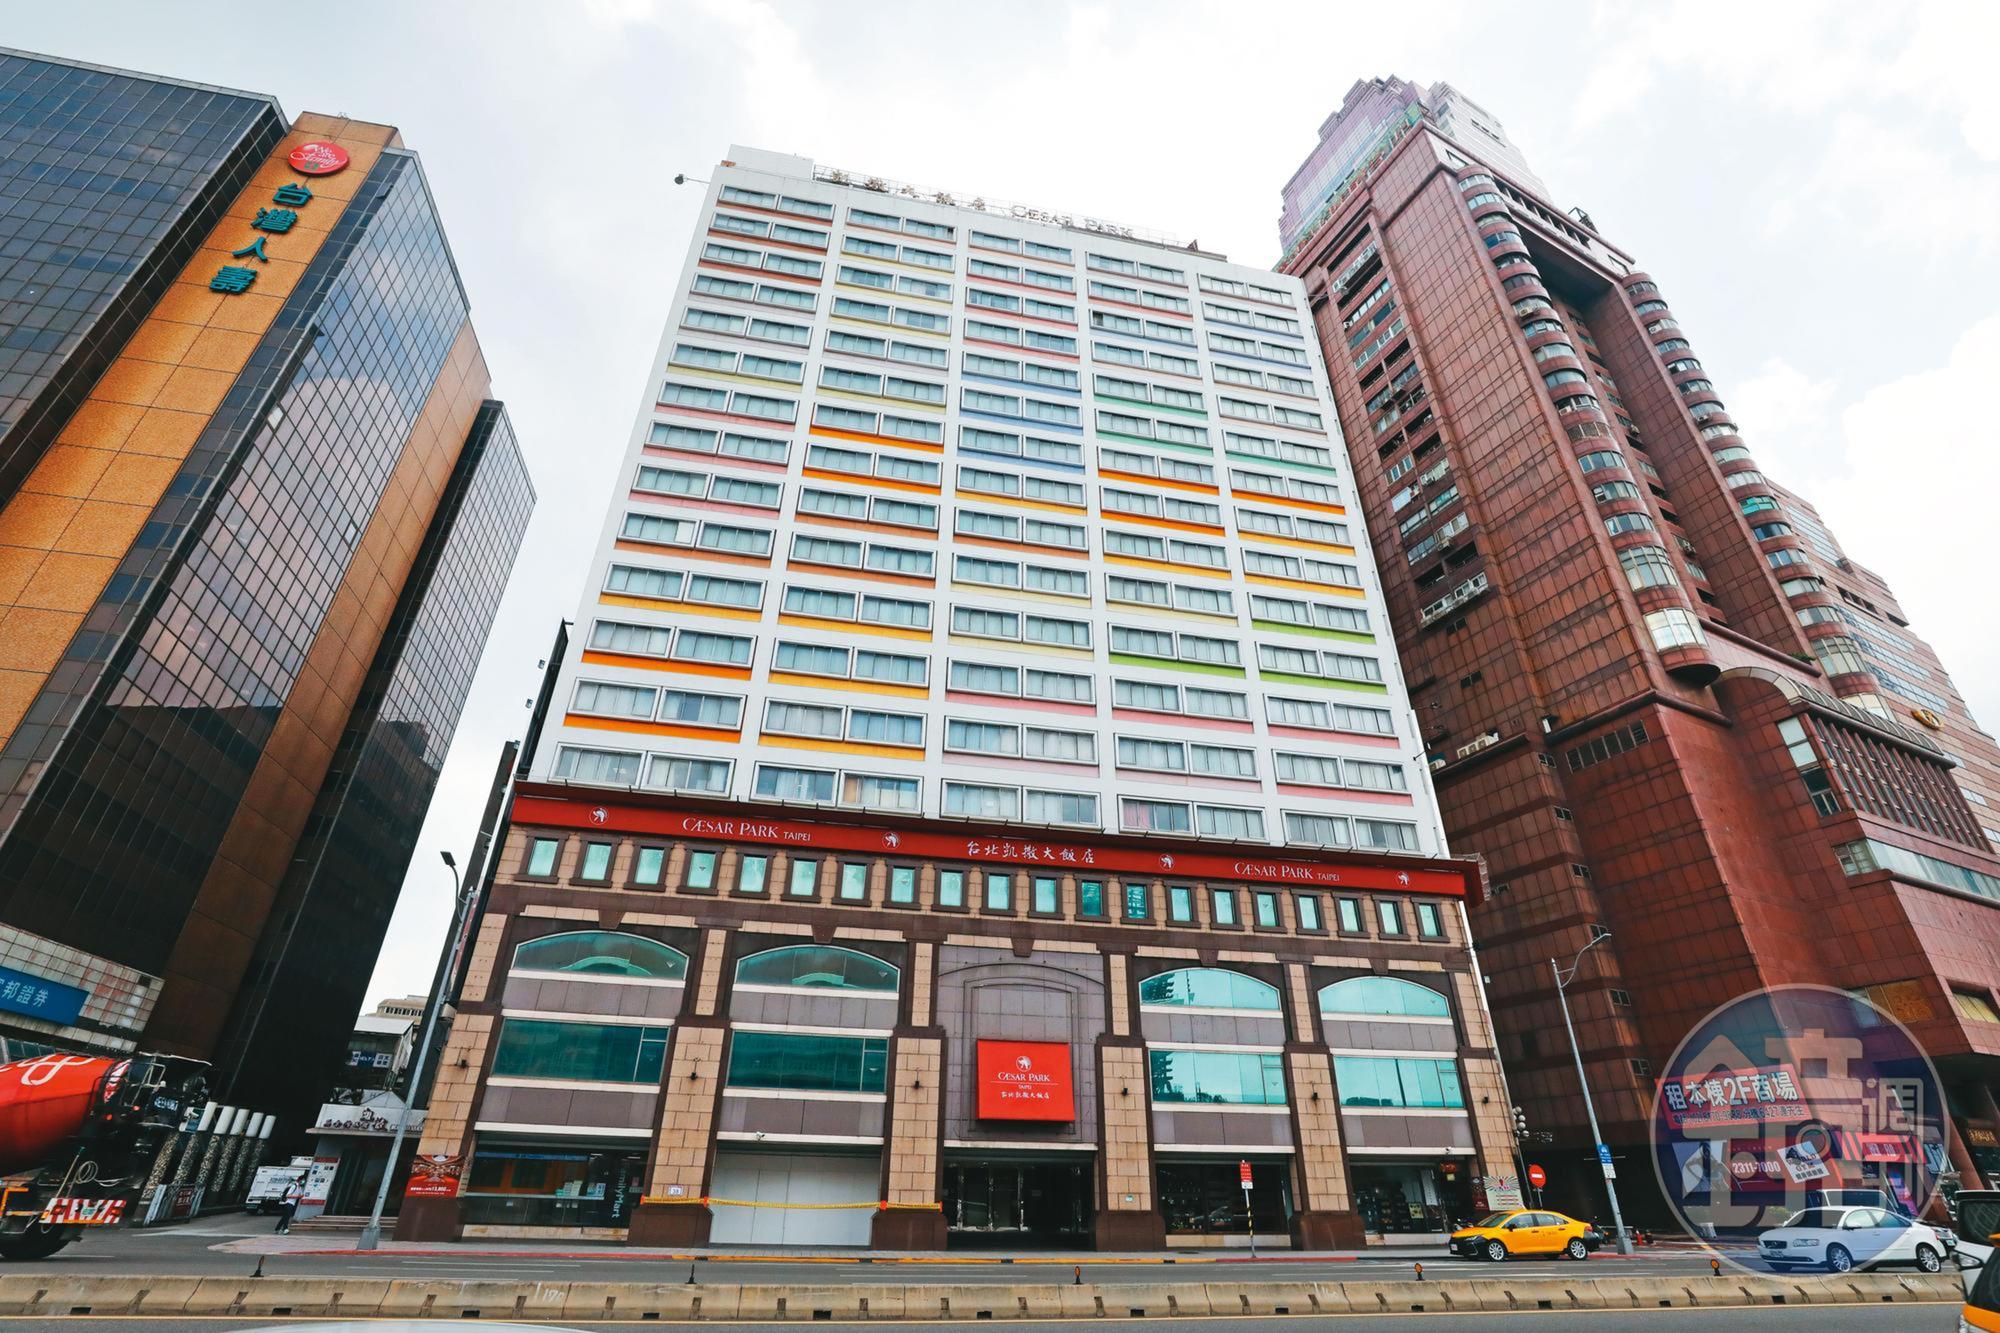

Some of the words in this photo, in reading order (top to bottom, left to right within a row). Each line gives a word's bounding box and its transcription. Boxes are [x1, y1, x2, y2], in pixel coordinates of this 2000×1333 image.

[209, 182, 314, 294] 台灣人壽
[739, 822, 779, 838] PARK
[783, 831, 811, 842] TAIPEI
[967, 840, 1095, 864] 台北凱撒大飯店
[1281, 865, 1314, 880] PARK
[1317, 872, 1340, 882] TAIPEI
[0, 978, 49, 1008] 邦證券
[1028, 1073, 1051, 1082] PARK
[611, 1162, 628, 1218] amilyMart
